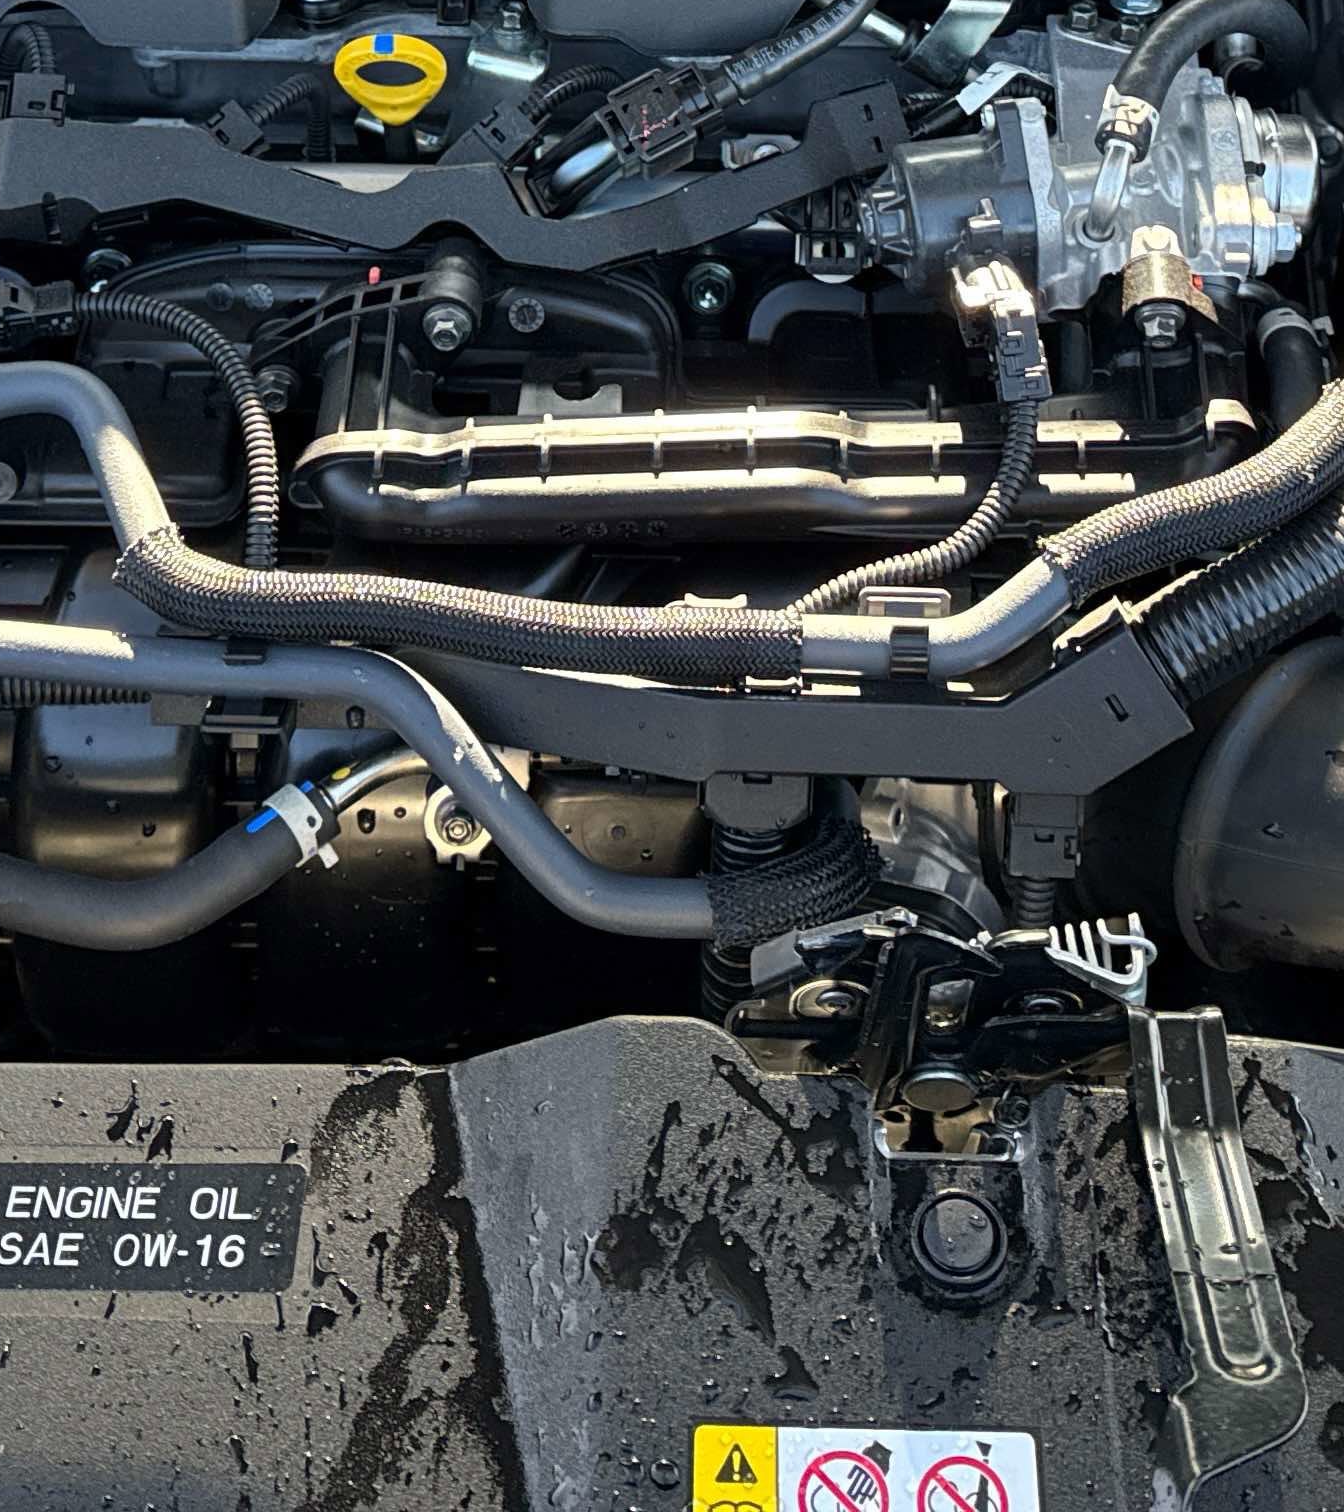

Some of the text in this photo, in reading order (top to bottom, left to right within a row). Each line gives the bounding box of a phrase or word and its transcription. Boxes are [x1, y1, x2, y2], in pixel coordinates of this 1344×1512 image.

[4, 1185, 254, 1221] ENGINE OIL
[113, 1233, 246, 1269] 0W-16
